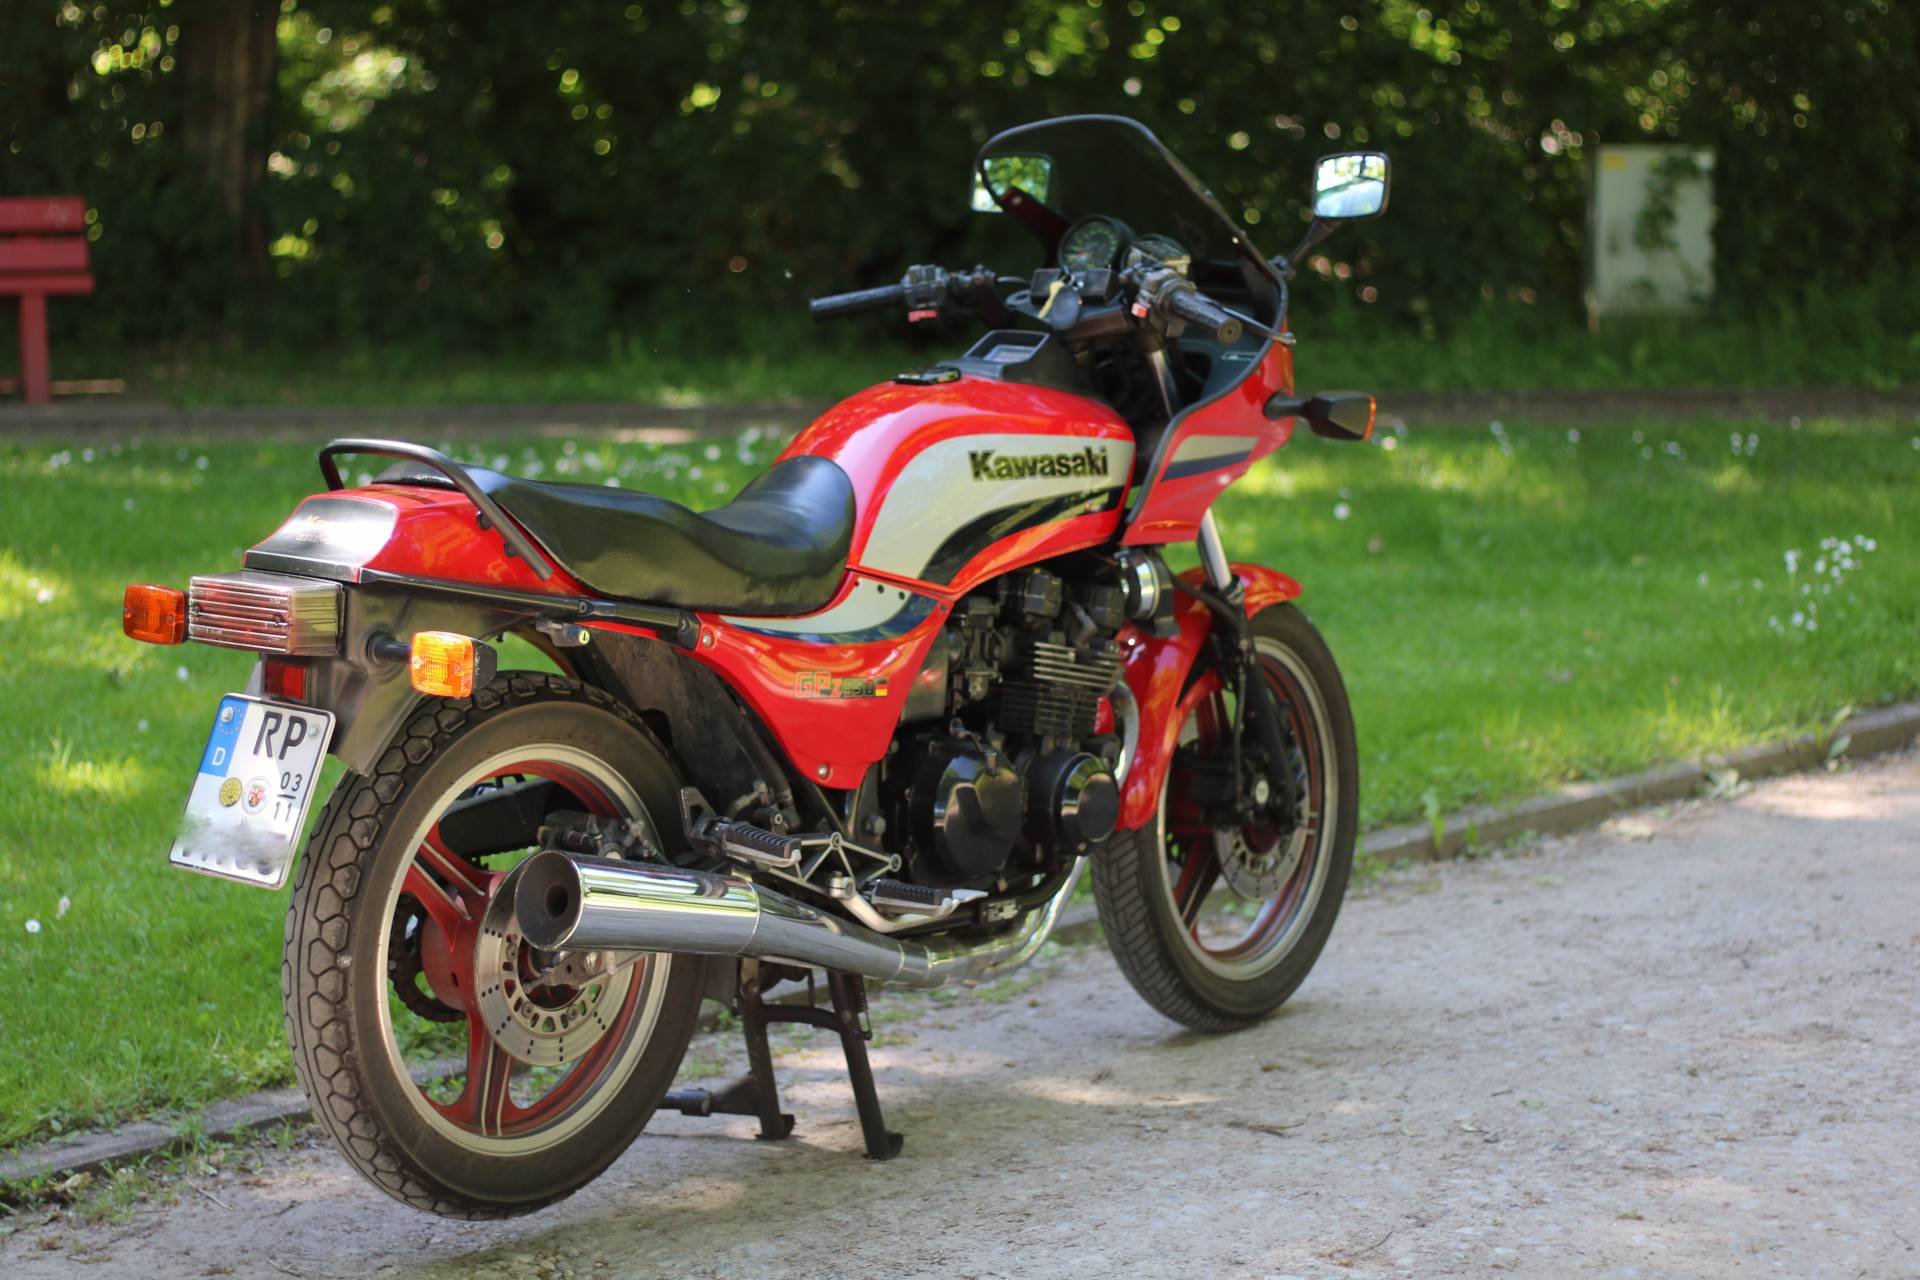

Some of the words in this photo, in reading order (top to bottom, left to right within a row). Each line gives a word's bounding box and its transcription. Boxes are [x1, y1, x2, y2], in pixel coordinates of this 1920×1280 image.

[968, 446, 1109, 481] Kawasaki
[253, 711, 307, 760] RP
[212, 747, 227, 766] D
[280, 771, 302, 792] 03
[274, 801, 292, 822] 11
